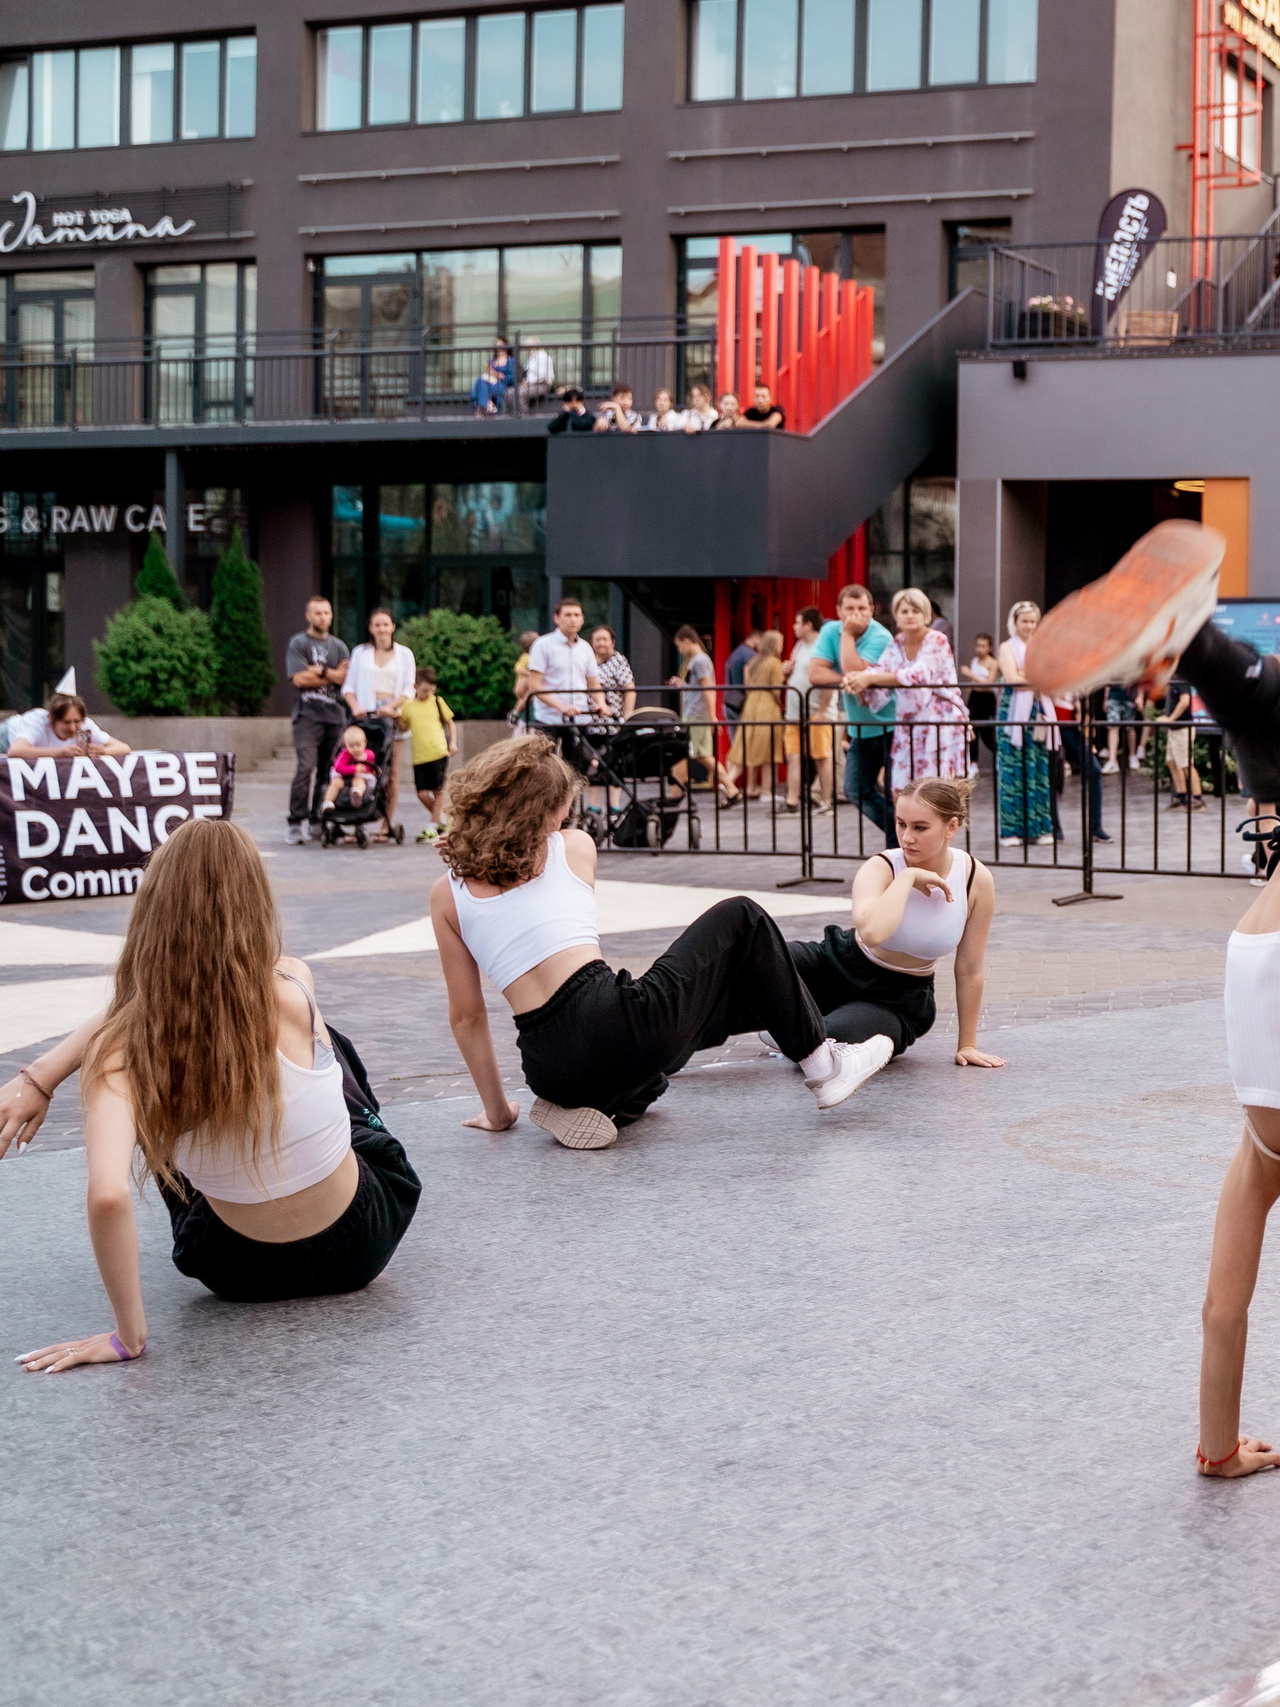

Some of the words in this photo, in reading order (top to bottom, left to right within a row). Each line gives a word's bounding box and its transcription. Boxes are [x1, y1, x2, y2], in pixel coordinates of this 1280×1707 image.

[52, 210, 85, 227] HOT
[90, 207, 133, 225] YOGA
[21, 505, 42, 534] &
[51, 504, 118, 533] RAW
[124, 503, 206, 532] CAE
[7, 752, 222, 801] MAYBE
[21, 866, 144, 900] Comm
